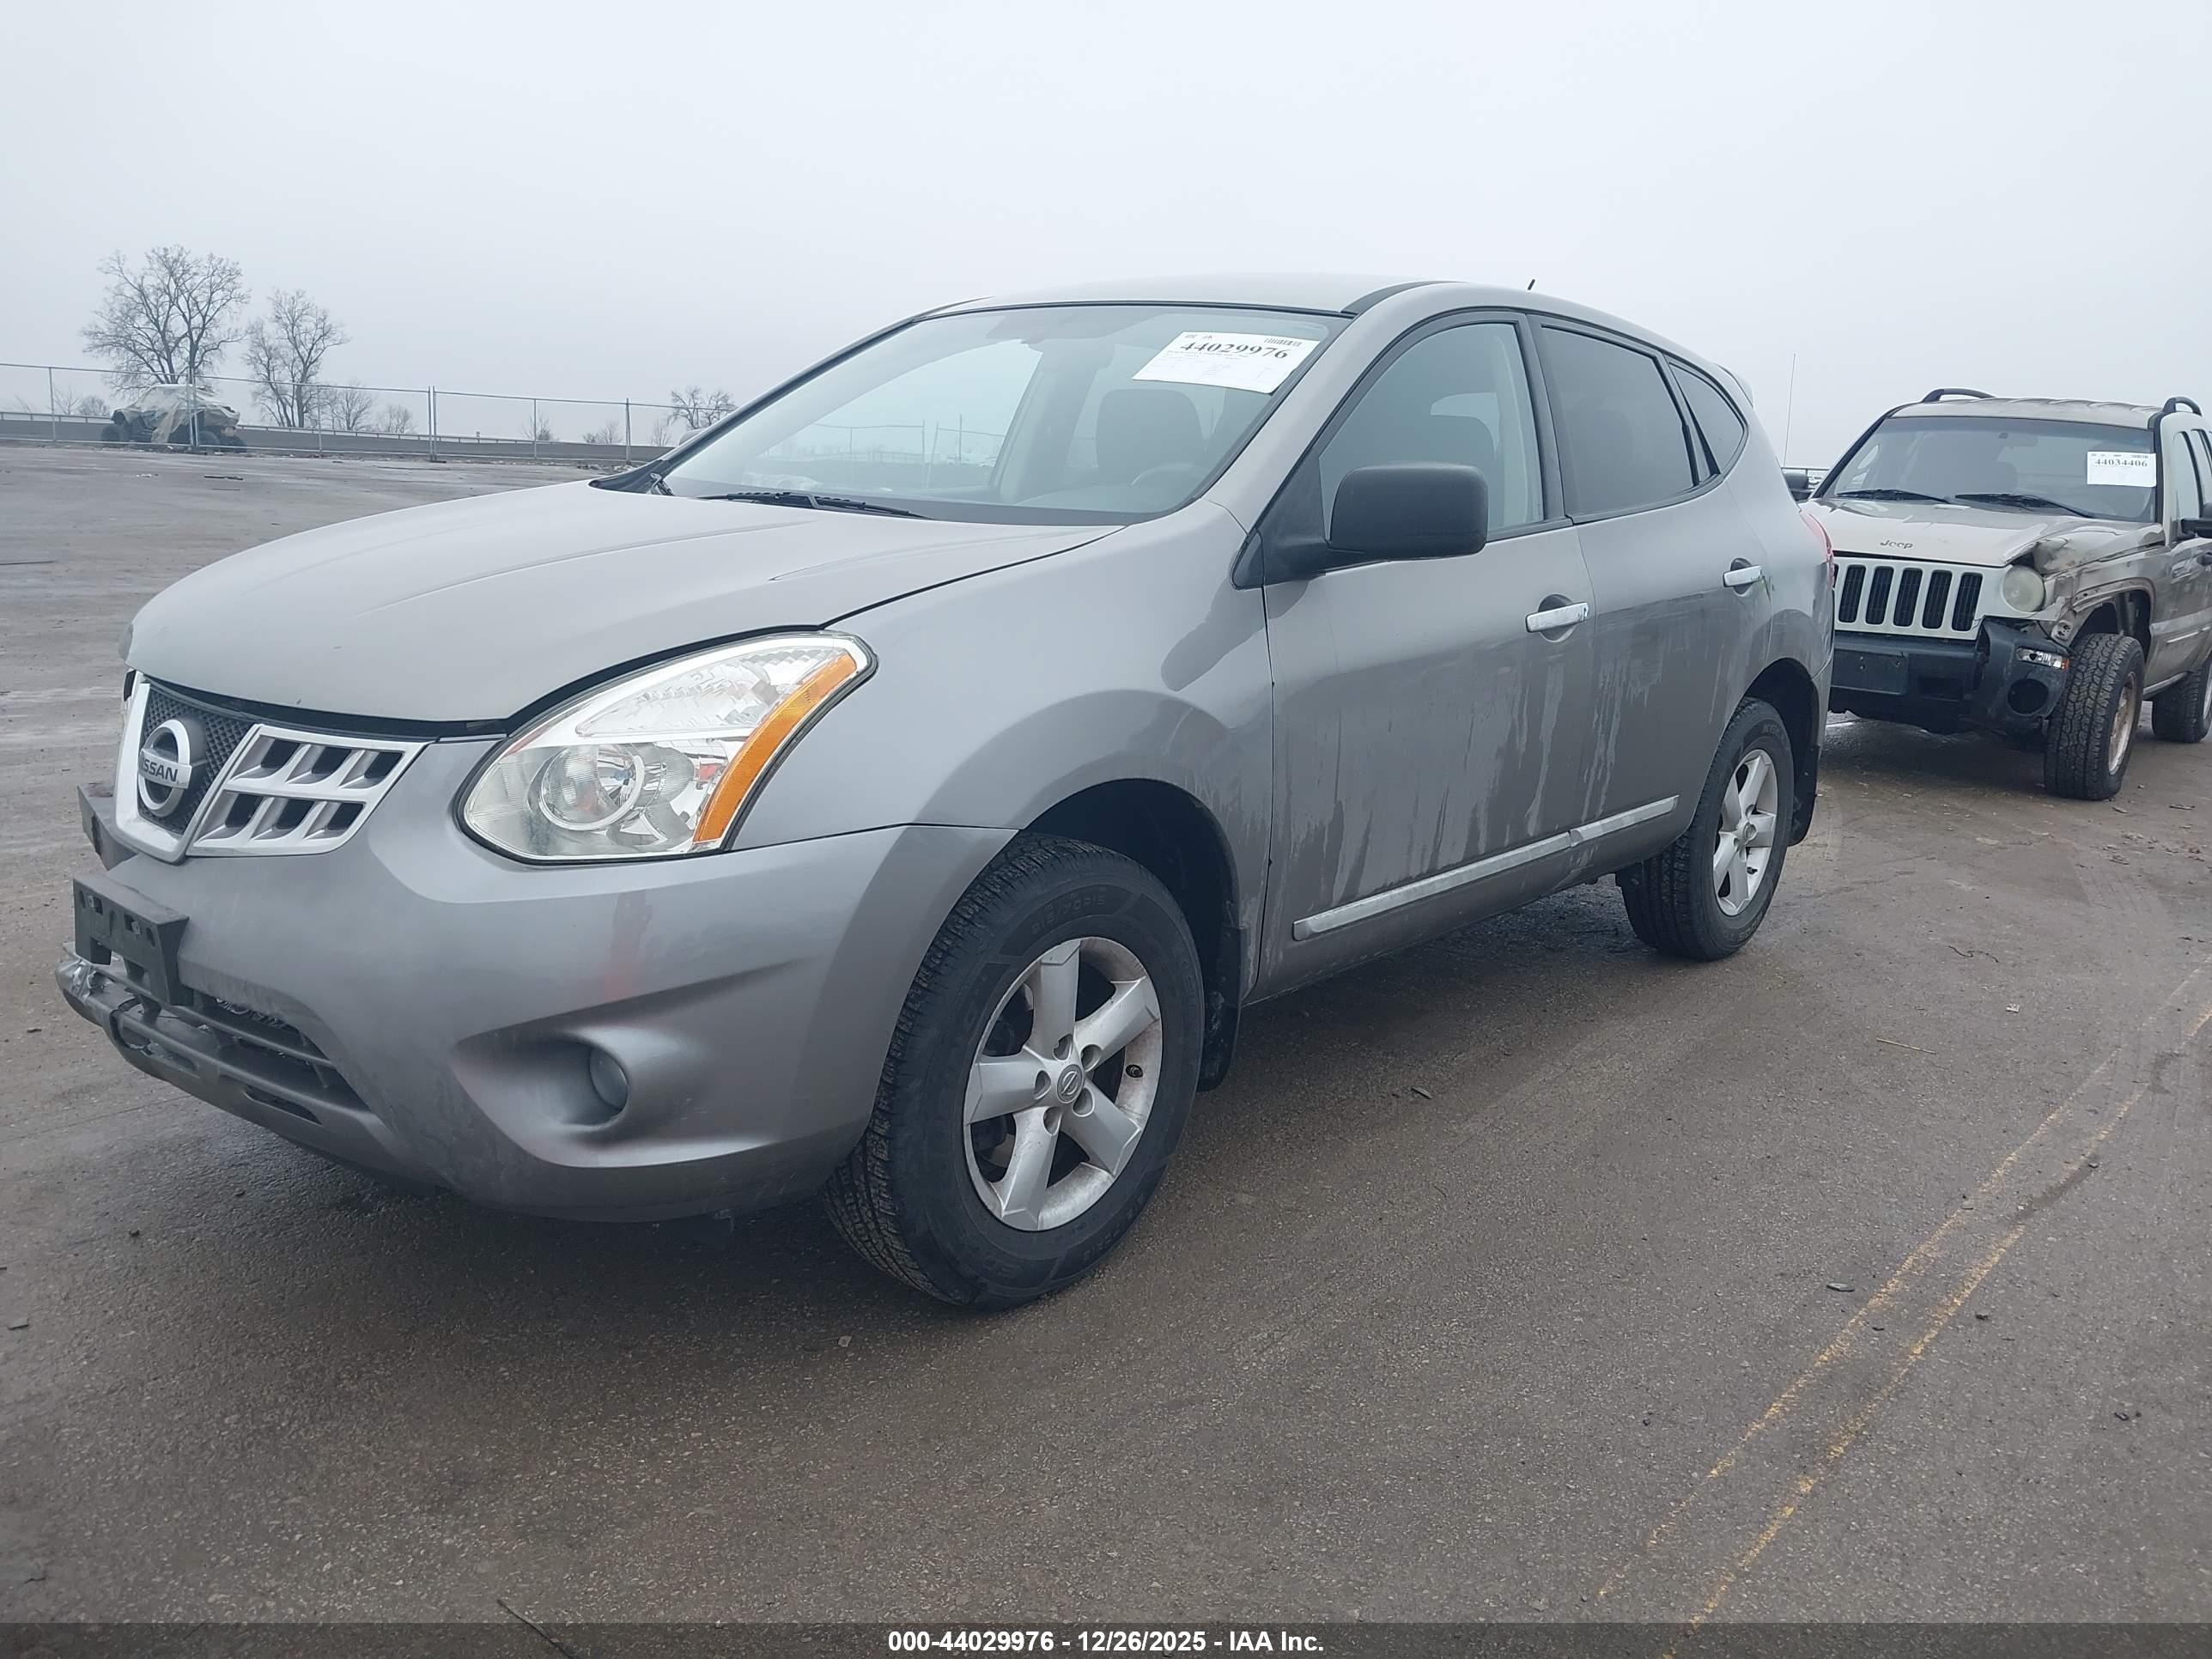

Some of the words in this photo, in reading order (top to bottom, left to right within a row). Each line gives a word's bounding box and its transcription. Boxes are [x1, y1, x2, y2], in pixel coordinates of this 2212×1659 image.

[1181, 341, 1291, 359] 44029976
[2094, 458, 2148, 467] 44034406
[1880, 539, 1914, 550] Jeep
[142, 758, 179, 782] SSAN
